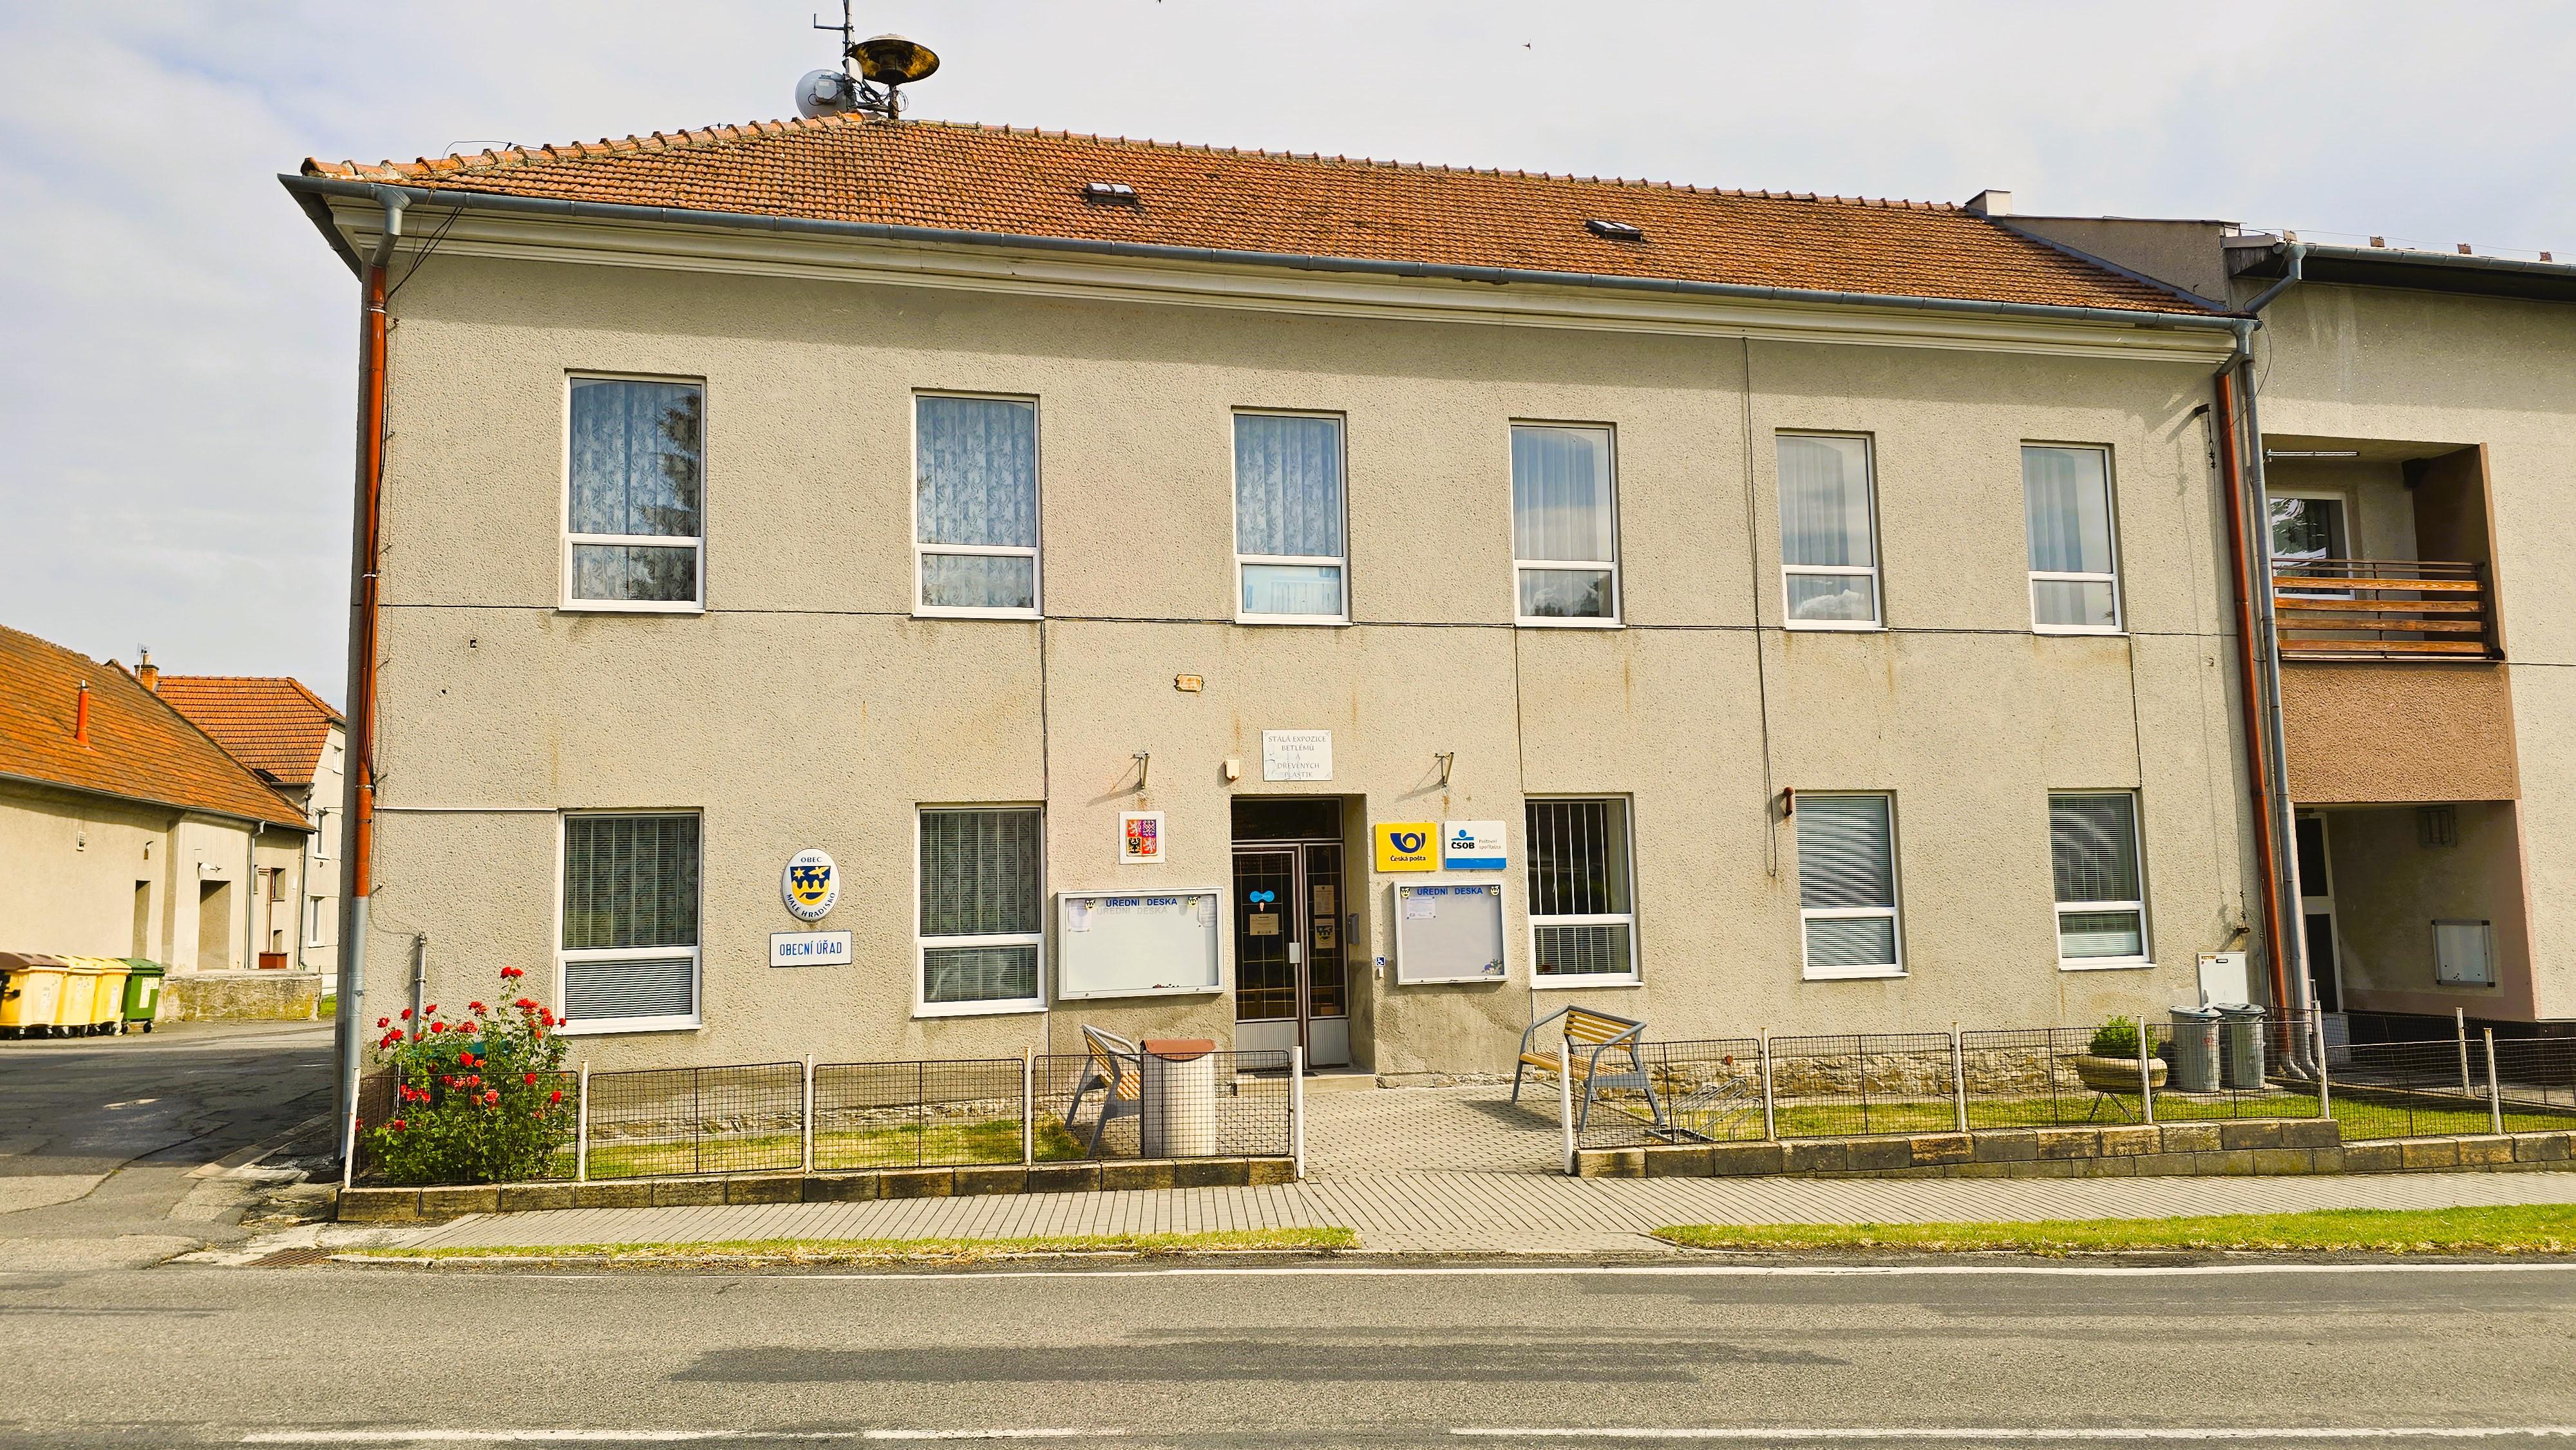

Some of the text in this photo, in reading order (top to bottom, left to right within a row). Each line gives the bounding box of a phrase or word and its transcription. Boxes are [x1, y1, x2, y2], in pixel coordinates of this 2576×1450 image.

[1451, 841, 1475, 849] ČSOB
[786, 892, 835, 918] MALÉ HRADISKO
[779, 939, 842, 956] OBECNÍ ÚŘAD
